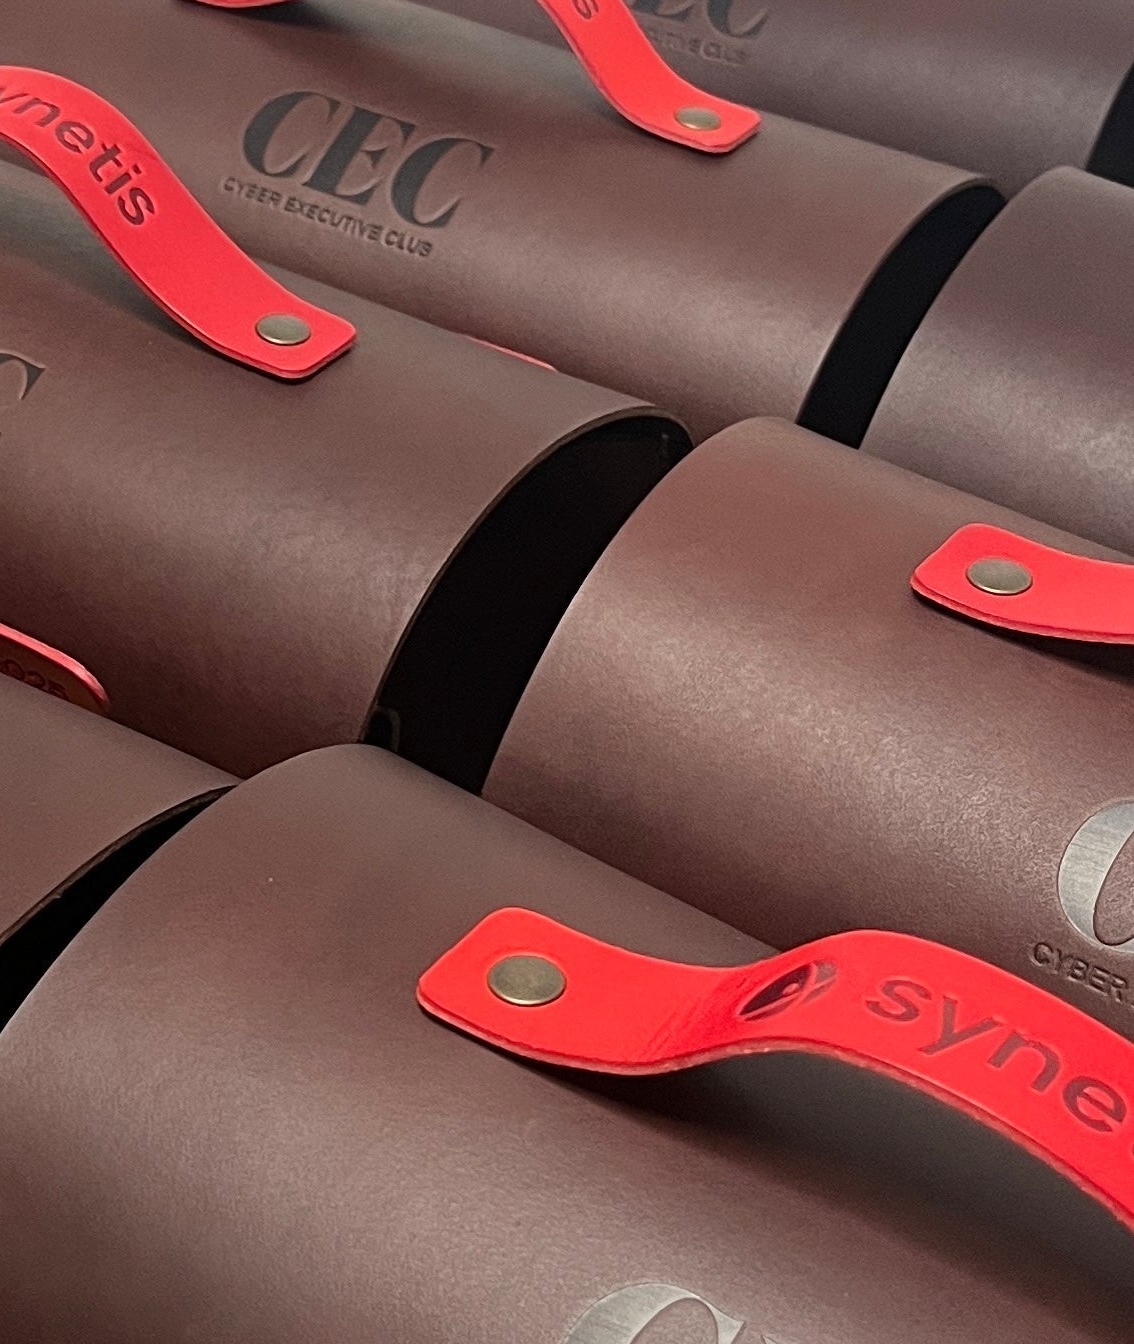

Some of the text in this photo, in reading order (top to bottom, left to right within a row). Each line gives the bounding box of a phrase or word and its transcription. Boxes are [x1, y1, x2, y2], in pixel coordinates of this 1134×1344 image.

[242, 90, 494, 229] CEC
[283, 195, 384, 241] EXECUTIVE
[383, 228, 434, 258] CLUB
[1031, 941, 1128, 1003] CYBER
[865, 979, 1134, 1156] syne
